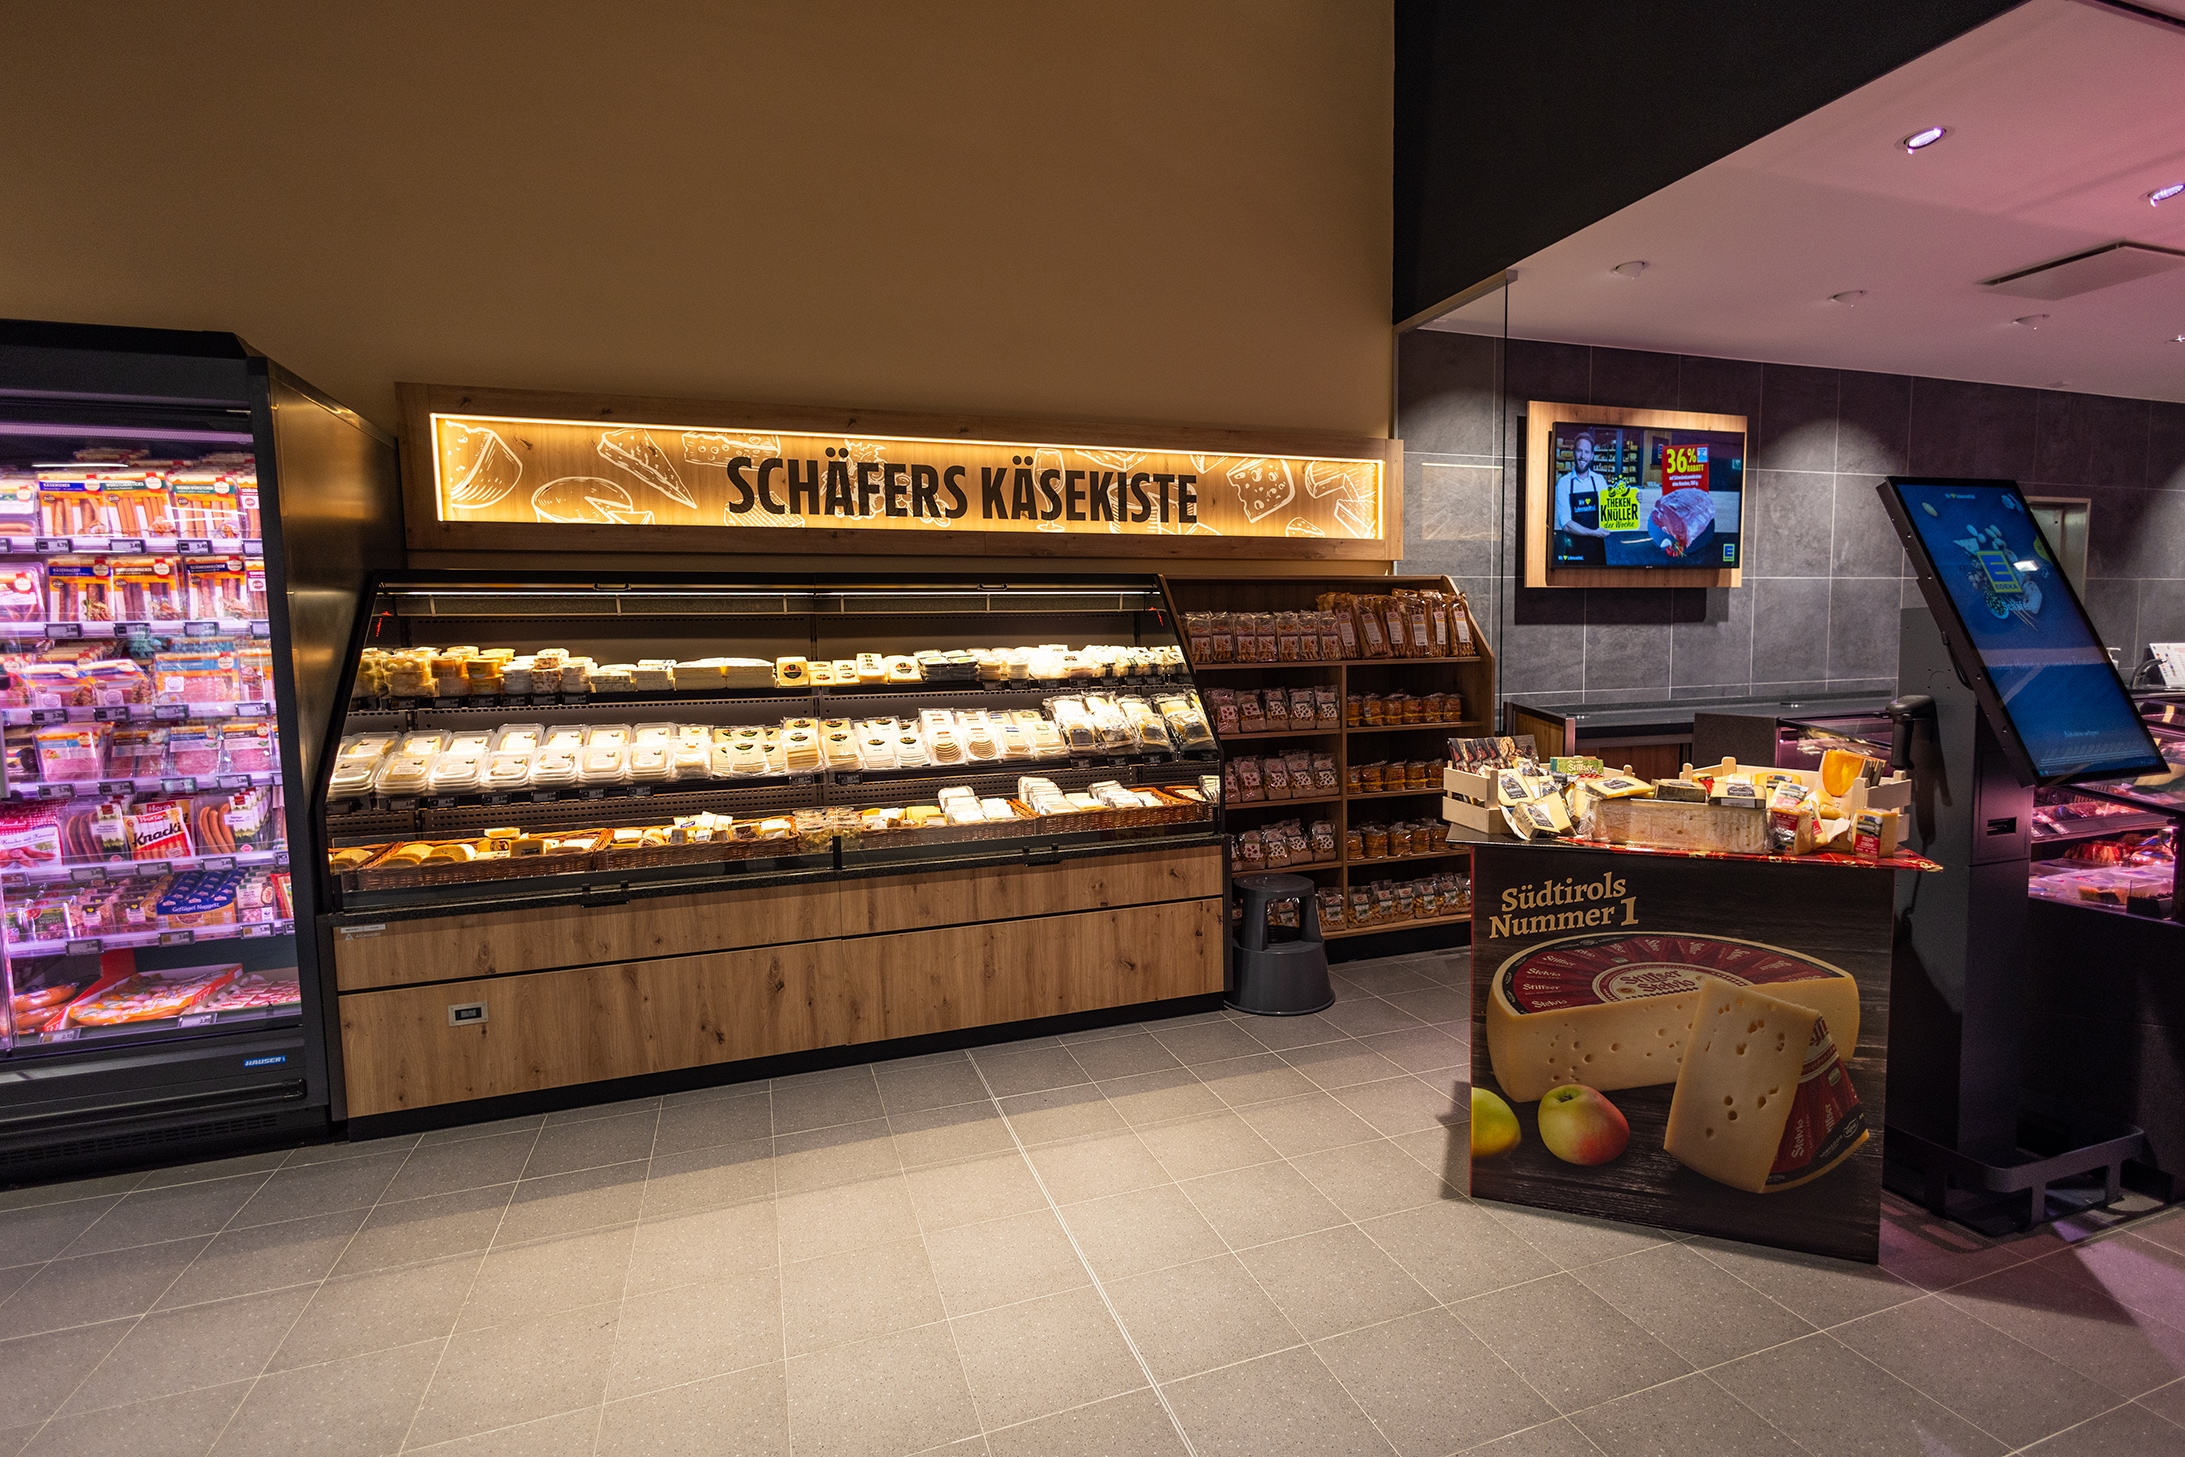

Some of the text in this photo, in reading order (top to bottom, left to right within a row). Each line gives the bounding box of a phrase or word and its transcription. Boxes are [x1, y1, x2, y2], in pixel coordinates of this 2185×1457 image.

[1687, 464, 1704, 472] RABATT
[727, 447, 1197, 524] SCHÄFERS KÄSEKISTE
[1607, 498, 1631, 507] THEKEN
[1601, 504, 1639, 521] KNÜLLER
[128, 820, 134, 828] 6
[133, 822, 183, 846] Knacki
[1501, 871, 1627, 912] Südtirols
[172, 904, 197, 912] Geflügel
[1489, 896, 1640, 939] Nummer 1
[1620, 970, 1682, 985] Stilfser
[1637, 980, 1696, 992] Stelvio
[245, 1056, 282, 1066] HAUSER
